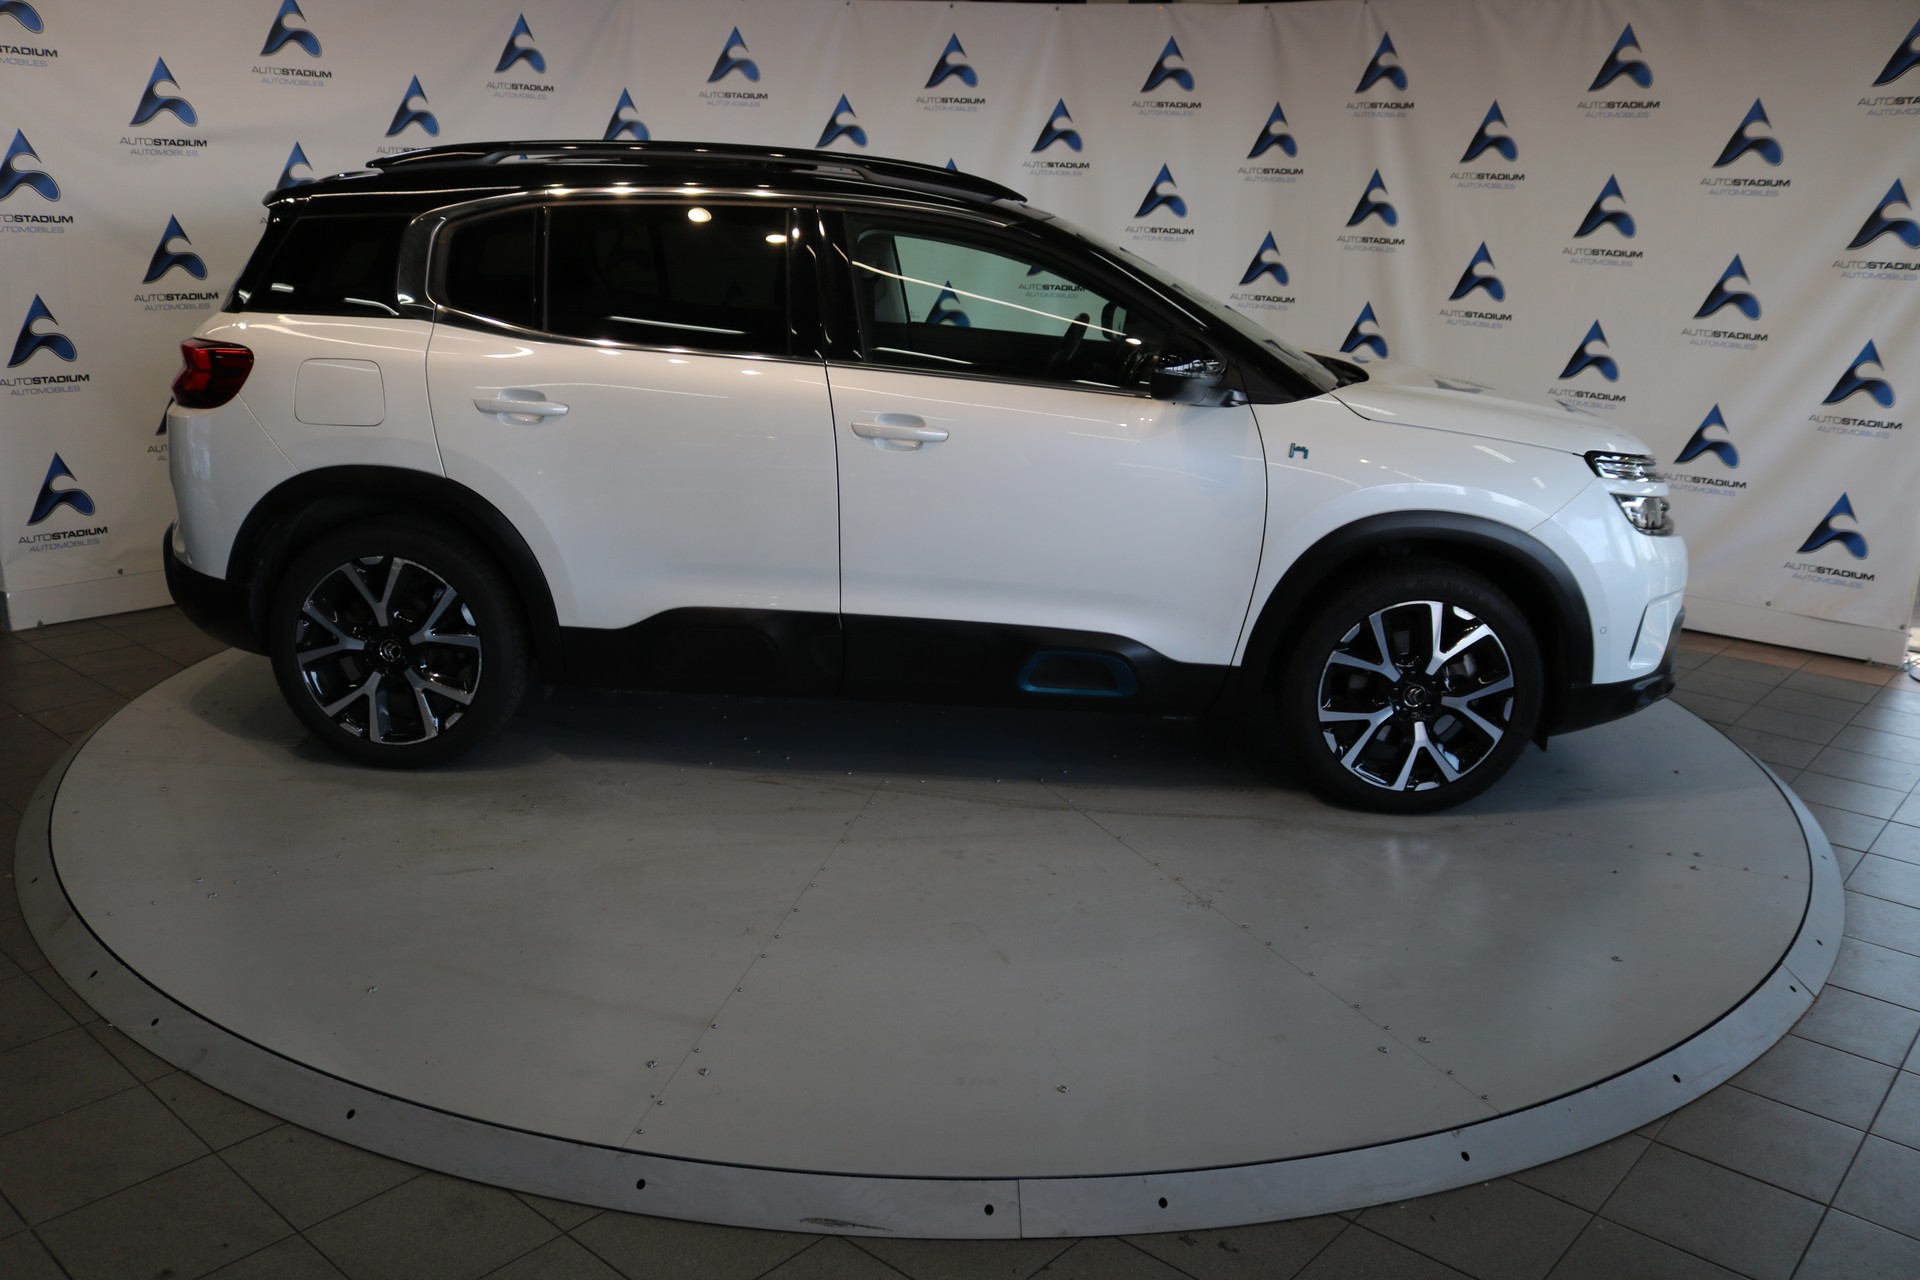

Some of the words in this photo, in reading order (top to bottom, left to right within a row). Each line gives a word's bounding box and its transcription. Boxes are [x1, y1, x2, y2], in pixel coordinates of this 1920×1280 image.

[0, 45, 58, 57] TADIUM
[251, 66, 332, 78] AUTOSTADIUM
[261, 77, 325, 87] AUTOMOBILES
[486, 82, 554, 92] AUTOSTADIUM
[494, 92, 548, 101] AUTOMOBILES
[699, 91, 768, 100] AUTOSTADIUM
[916, 96, 986, 105] AUTOSTADIUM
[706, 100, 761, 108] AUTOMOBILES
[923, 105, 978, 113] AUTOMOBILES
[1132, 100, 1202, 110] AUTOSTADIUM
[1345, 101, 1414, 110] AUTOSTADIUM
[1577, 100, 1660, 110] AUTOSTADIUM
[1139, 109, 1194, 117] AUTOMOBILES
[1352, 110, 1407, 118] AUTOMOBILES
[1584, 110, 1650, 119] AUTOMOBILES
[119, 136, 208, 148] AUTOSTADIUM
[130, 148, 199, 157] AUTOMOBILES
[1022, 160, 1090, 170] AUTOSTADIUM
[1029, 169, 1083, 177] AUTOMOBILES
[1237, 166, 1304, 176] AUTOSTADIUM
[1449, 171, 1525, 181] AUTOSTADIUM
[1244, 175, 1297, 183] AUTOMOBILES
[1699, 178, 1791, 188] AUTOSTADIUM
[1457, 181, 1516, 190] AUTOMOBILES
[1708, 188, 1779, 197] AUTOMOBILES
[1125, 225, 1195, 236] AUTOSTADIUM
[1132, 235, 1187, 243] AUTOMOBILES
[1336, 235, 1406, 245] AUTOSTADIUM
[1343, 245, 1397, 254] AUTOMOBILES
[1561, 247, 1644, 258] AUTOSTADIUM
[1569, 257, 1634, 267] AUTOMOBILES
[1832, 260, 1920, 271] AUTOSTADIU
[1840, 271, 1918, 280] AUTOMOBILES
[133, 291, 220, 302] AUTOSTADIUM
[1025, 291, 1079, 299] AUTOMOBILES
[1229, 292, 1296, 304] AUTOSTADIUM
[143, 303, 210, 312] AUTOMOBILES
[1236, 303, 1288, 311] AUTOMOBILES
[1439, 308, 1513, 321] AUTOSTADIUM
[1446, 319, 1504, 329] AUTOMOBILES
[1681, 327, 1768, 341] AUTOSTADIUM
[1689, 339, 1758, 350] AUTOMOBILES
[0, 374, 90, 387] AUTOSTADIUM
[10, 385, 80, 396] AUTOMOBILES
[1547, 387, 1627, 402] AUTOSTADIUM
[1808, 414, 1903, 430] AUTOSTADIUM
[1816, 426, 1890, 439] AUTOMOBILES
[1662, 472, 1748, 489] AUTOSTADIUM
[1669, 484, 1737, 497] AUTOMOBILES
[18, 526, 108, 544] AUTOSTADIUM
[28, 538, 100, 552] AUTOMOBILES
[1783, 561, 1876, 582] AUTOSTADIUM
[1791, 573, 1863, 589] AUTOMOBILES
